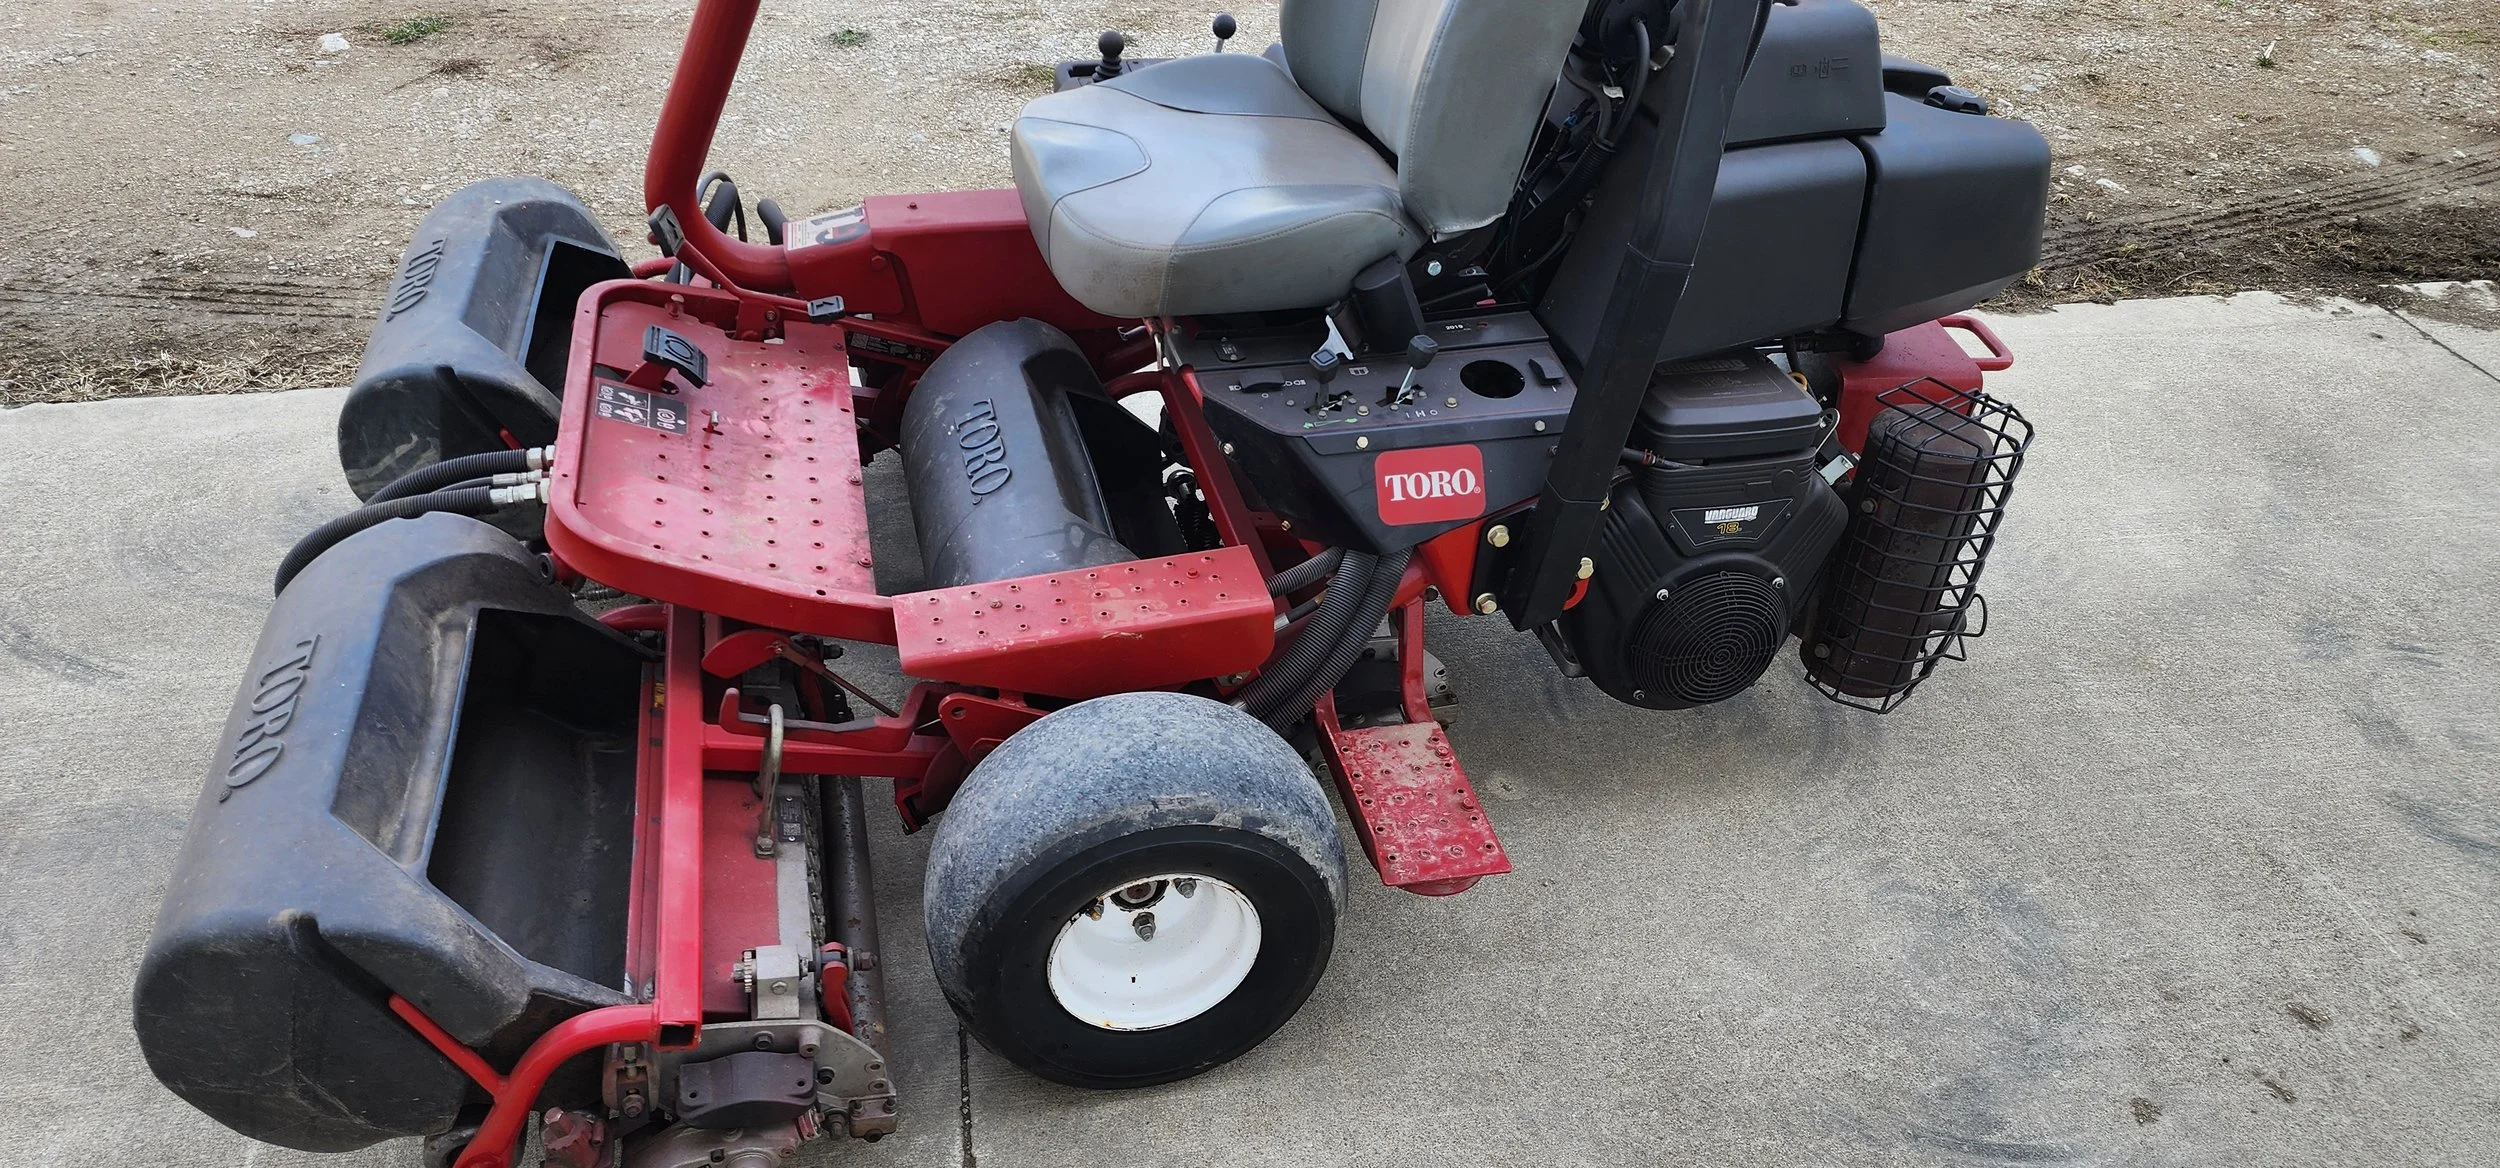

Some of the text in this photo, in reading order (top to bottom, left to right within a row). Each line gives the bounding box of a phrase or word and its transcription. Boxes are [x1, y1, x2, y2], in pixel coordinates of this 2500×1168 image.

[389, 236, 447, 314] TORO
[954, 398, 1012, 495] TORO
[1384, 468, 1476, 501] TORO
[1704, 506, 1759, 521] VANGUARD
[225, 634, 321, 788] TORO
